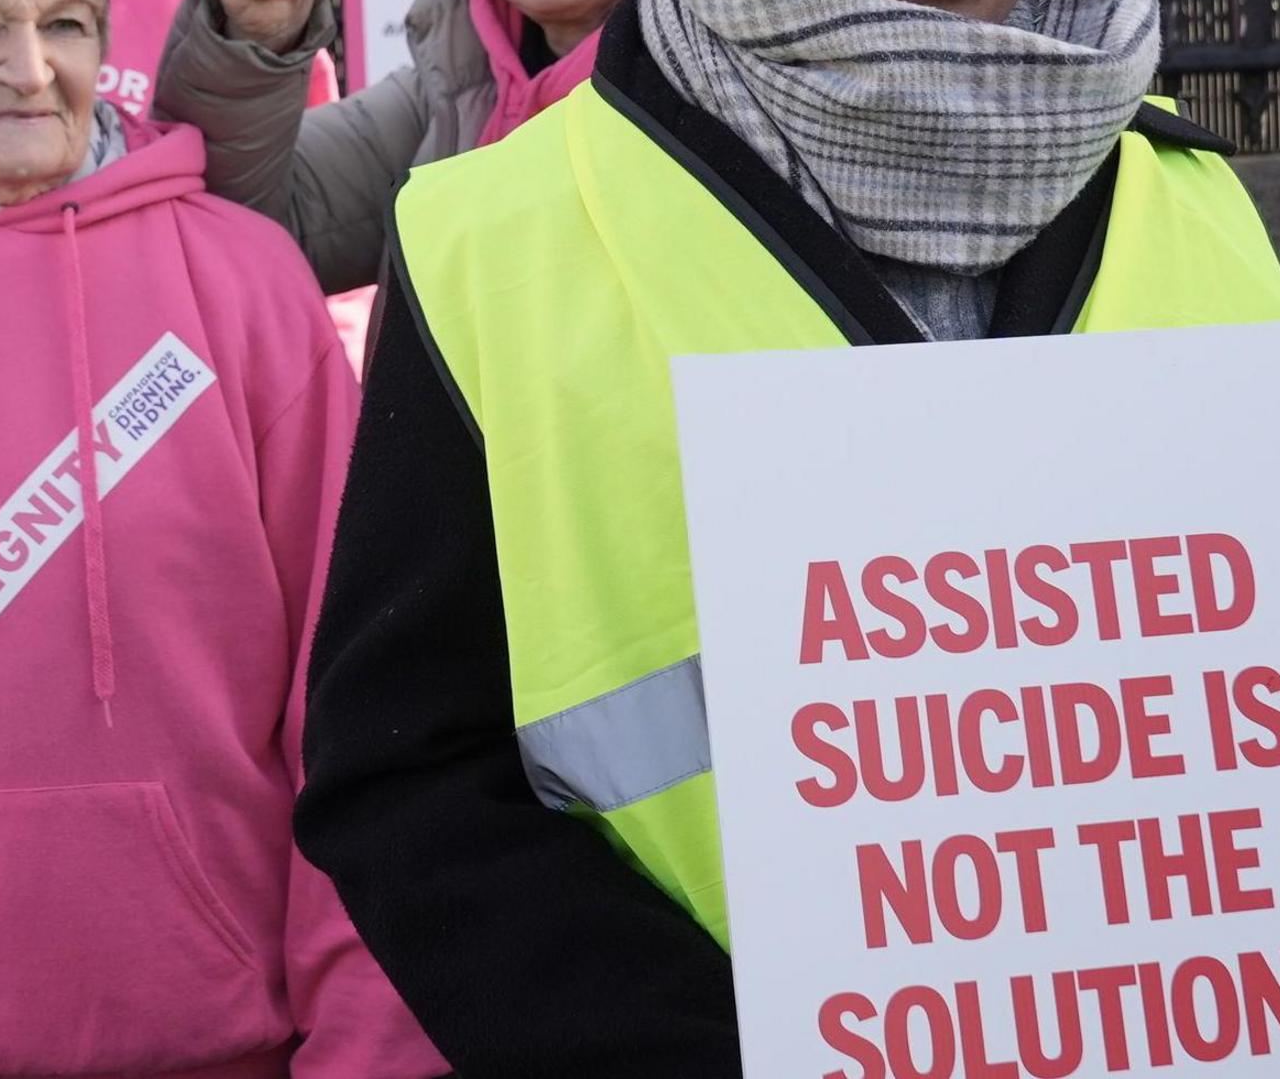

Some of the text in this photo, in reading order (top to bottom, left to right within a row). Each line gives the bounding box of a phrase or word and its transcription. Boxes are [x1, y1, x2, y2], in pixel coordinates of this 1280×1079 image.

[94, 65, 150, 102] OR
[108, 350, 174, 419] CAMPAIGN FOR
[115, 358, 182, 430] DIGNITY
[127, 369, 201, 441] IN DYING.
[798, 532, 1257, 665] ASSISTED
[790, 675, 1187, 808] SUICIDE
[856, 808, 1276, 949] NOT THE
